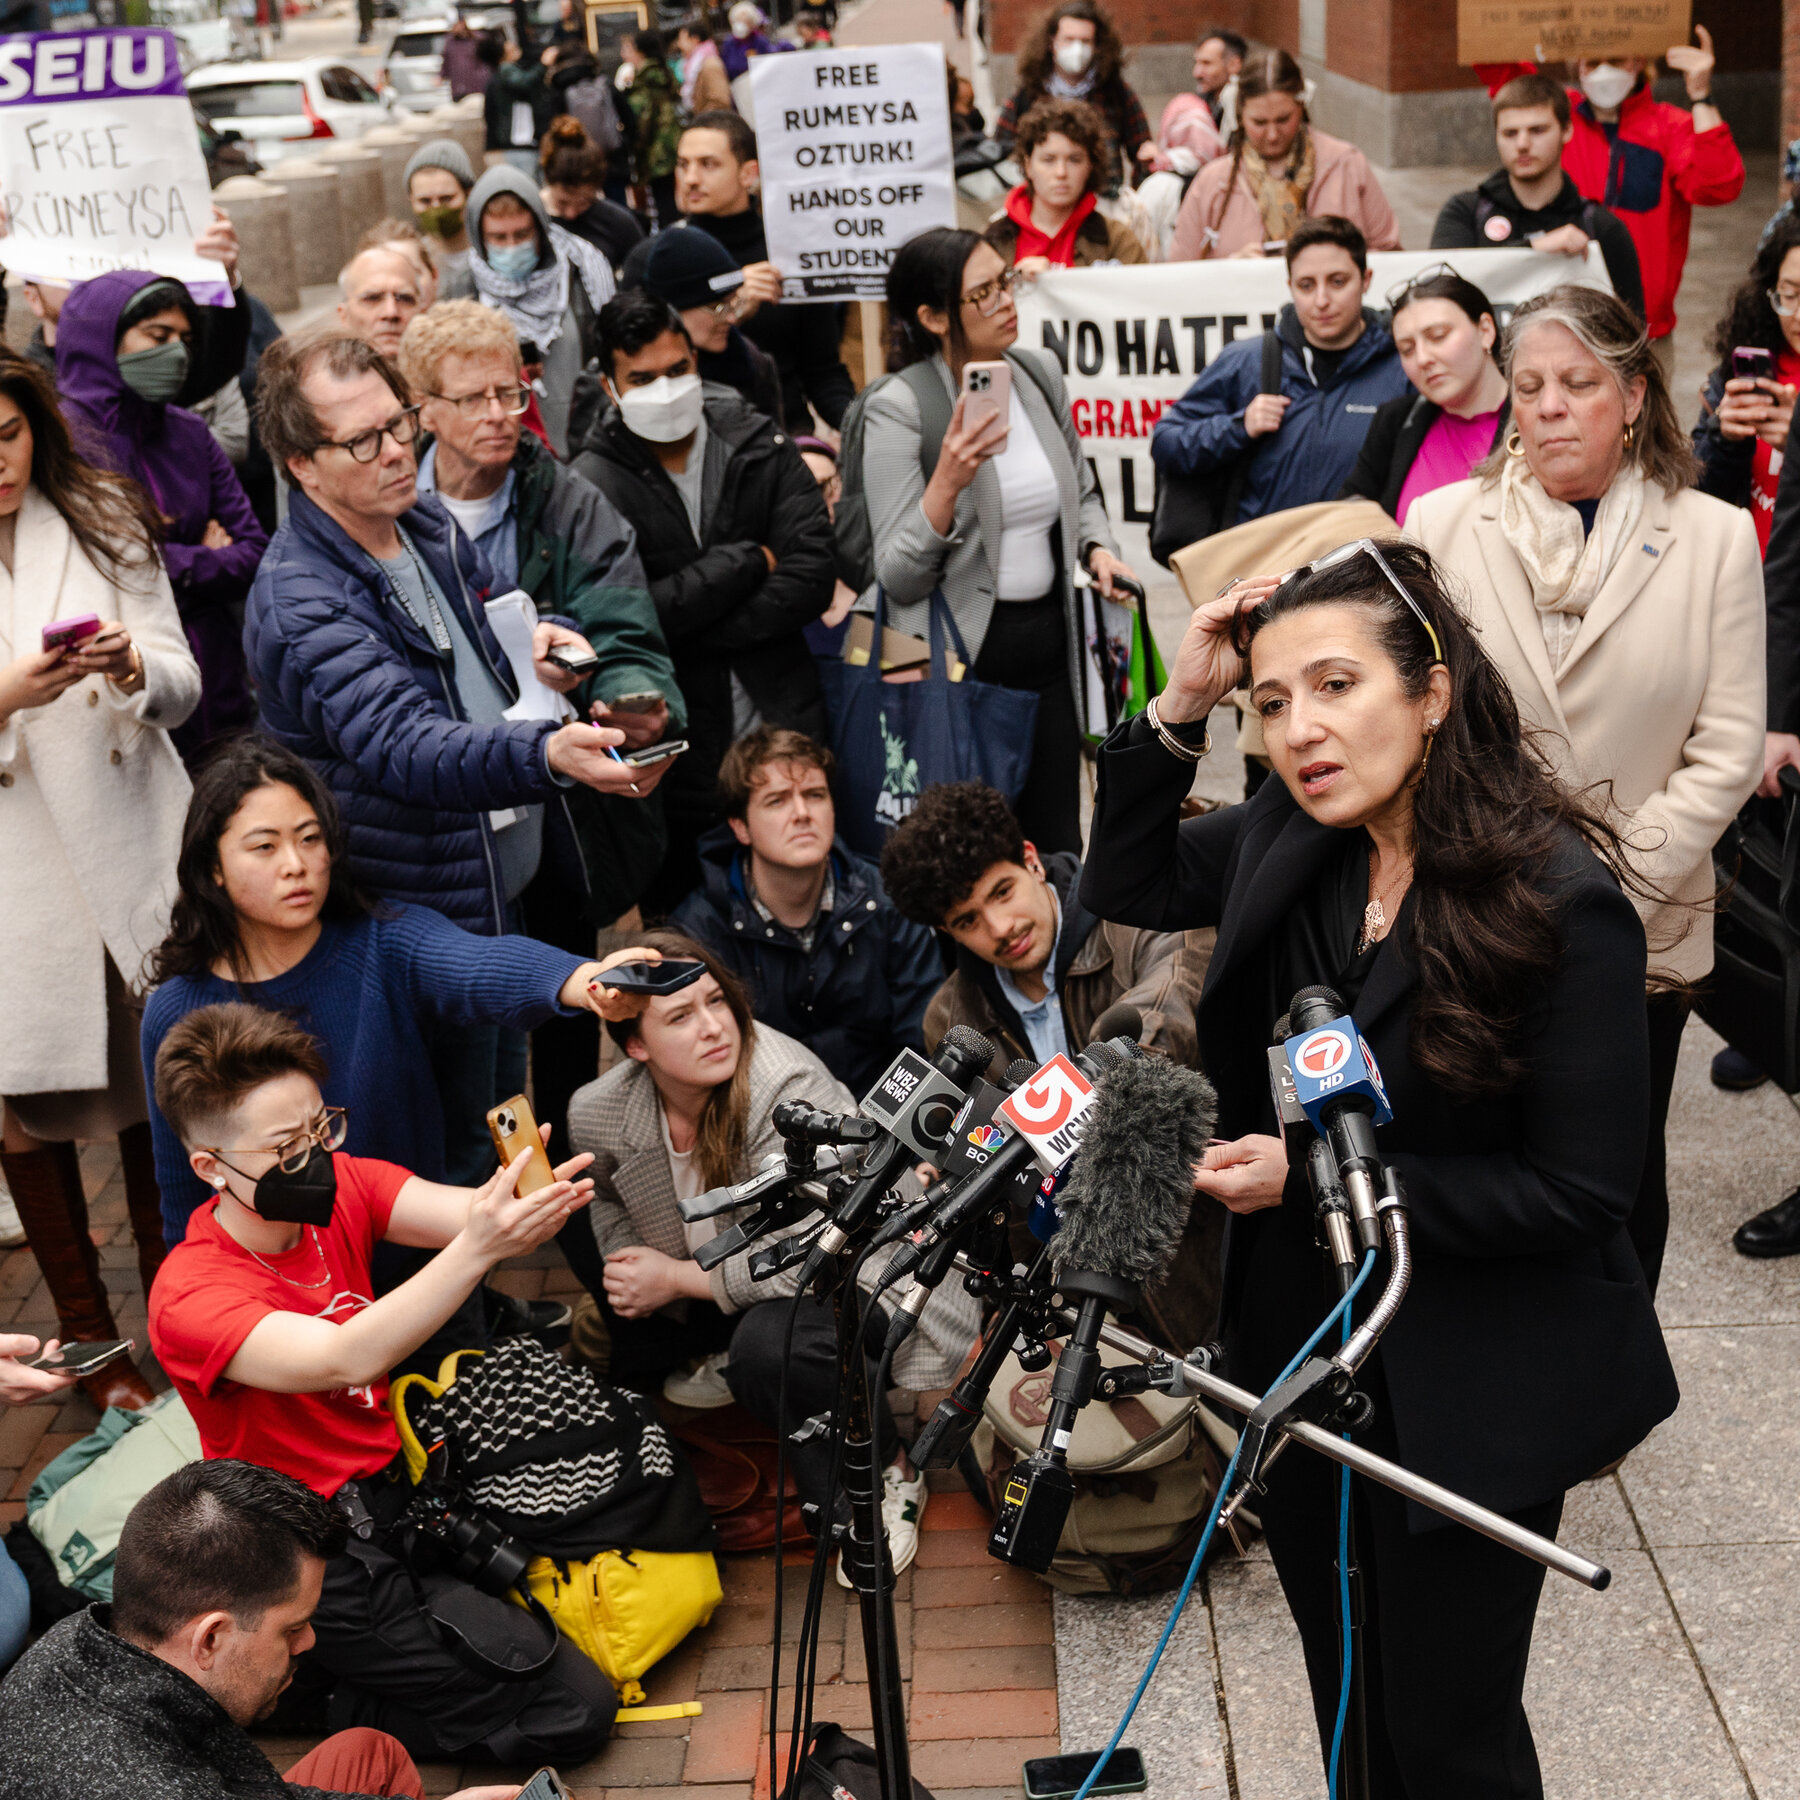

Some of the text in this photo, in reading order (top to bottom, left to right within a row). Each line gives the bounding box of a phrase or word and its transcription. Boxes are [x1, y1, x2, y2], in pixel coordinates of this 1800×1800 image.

[0, 35, 167, 101] SEIU
[815, 63, 879, 88] FREE
[785, 101, 918, 131] RUMEYSA
[24, 119, 130, 171] FREE
[795, 141, 914, 168] OZTURK!
[4, 184, 194, 239] RÜMEYSA
[789, 184, 925, 212] HANDS OFF
[834, 218, 884, 237] OUR
[799, 248, 899, 270] STUDENT
[1042, 319, 1104, 376] NO
[881, 1078, 909, 1103] NEWS
[892, 1065, 920, 1092] WBZ
[1319, 1072, 1345, 1092] HD
